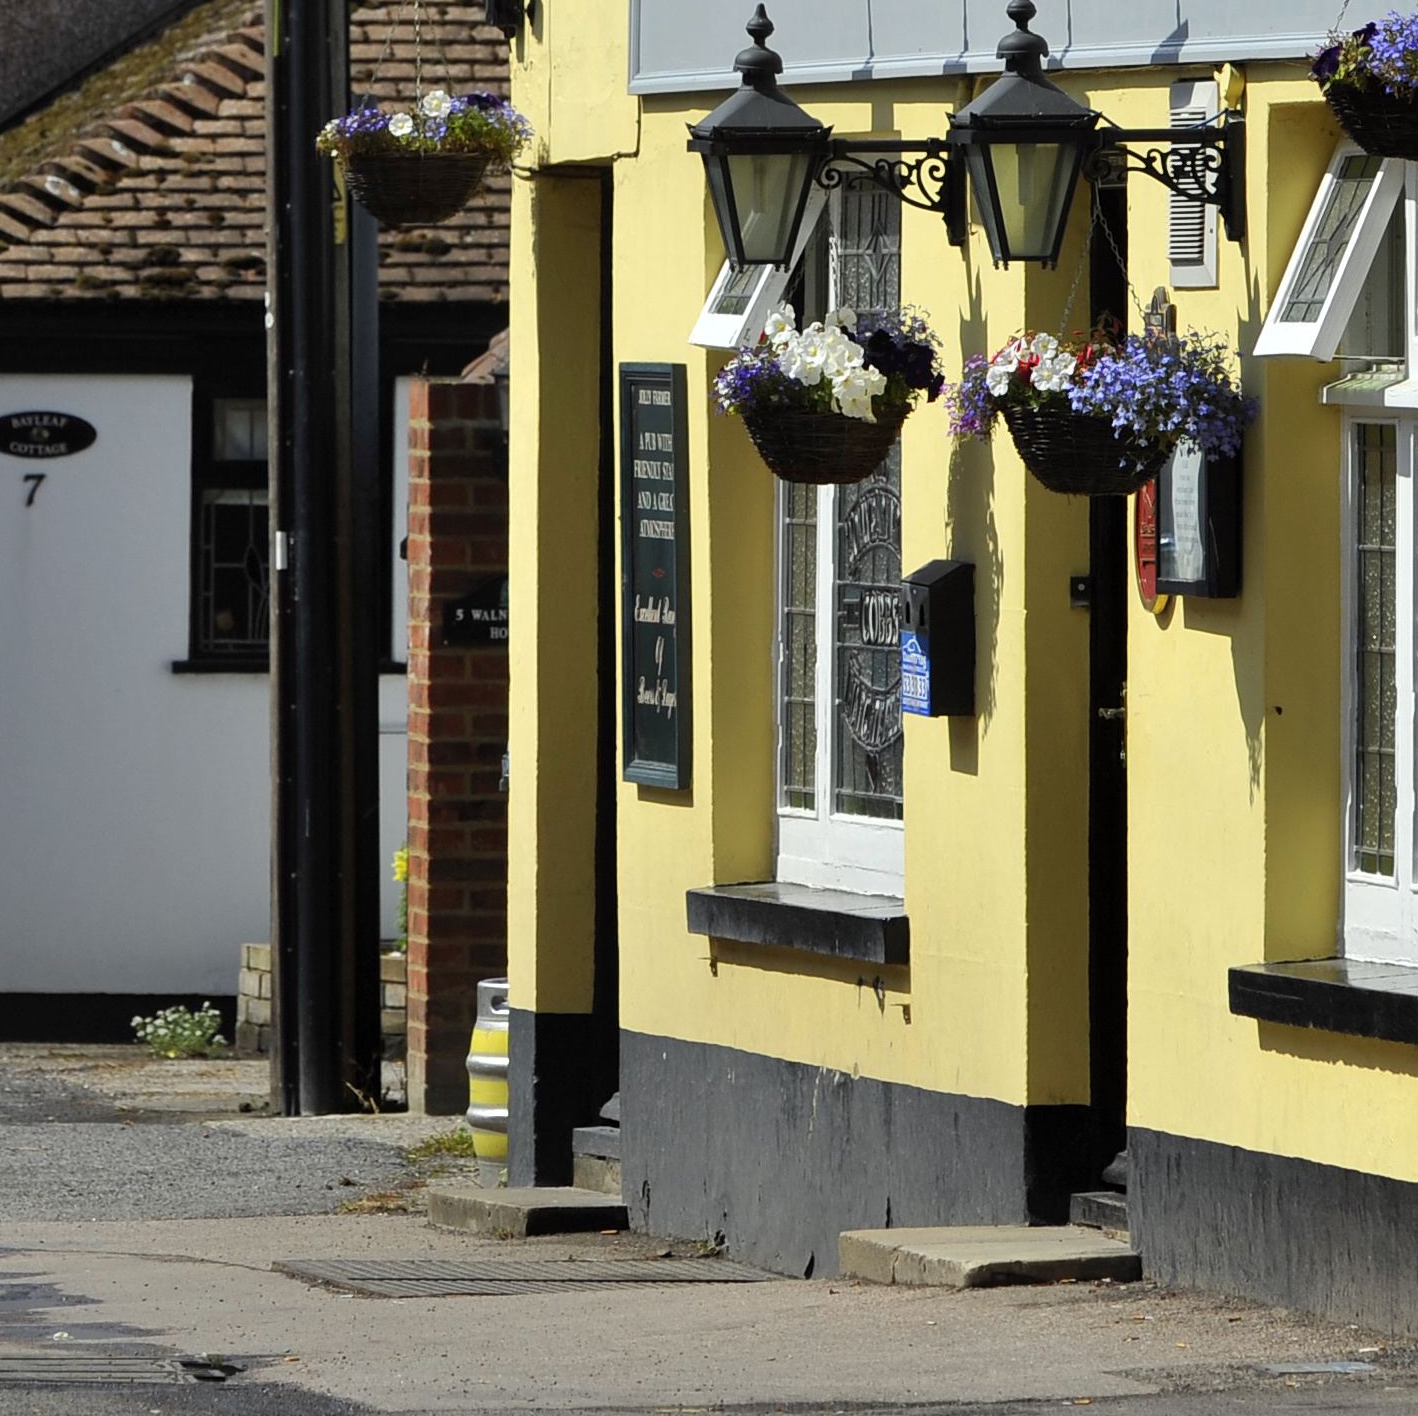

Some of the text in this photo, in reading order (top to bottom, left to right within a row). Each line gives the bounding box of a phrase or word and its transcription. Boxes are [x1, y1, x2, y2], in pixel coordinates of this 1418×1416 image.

[9, 441, 68, 456] COTTAGE
[639, 432, 644, 450] A
[644, 431, 657, 451] PUB
[23, 473, 47, 508] 7
[637, 491, 651, 510] AND
[652, 492, 658, 511] A
[455, 608, 464, 621] 5
